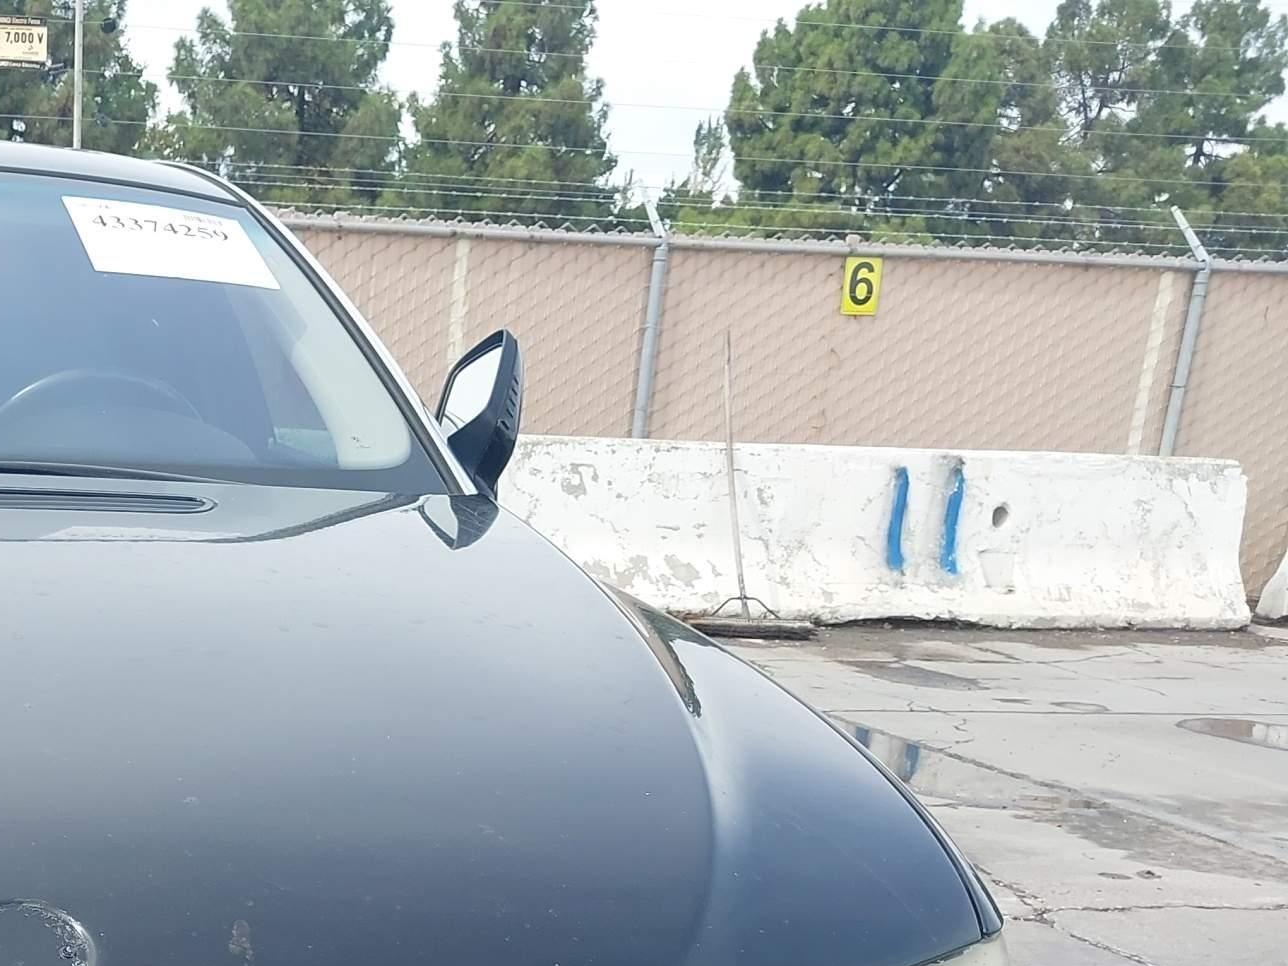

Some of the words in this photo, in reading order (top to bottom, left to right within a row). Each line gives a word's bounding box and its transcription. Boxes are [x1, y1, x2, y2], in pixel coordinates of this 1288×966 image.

[5, 31, 34, 44] 7,000
[37, 32, 44, 44] V
[92, 214, 229, 241] 43374259
[849, 261, 875, 306] 6
[885, 464, 966, 576] 11
